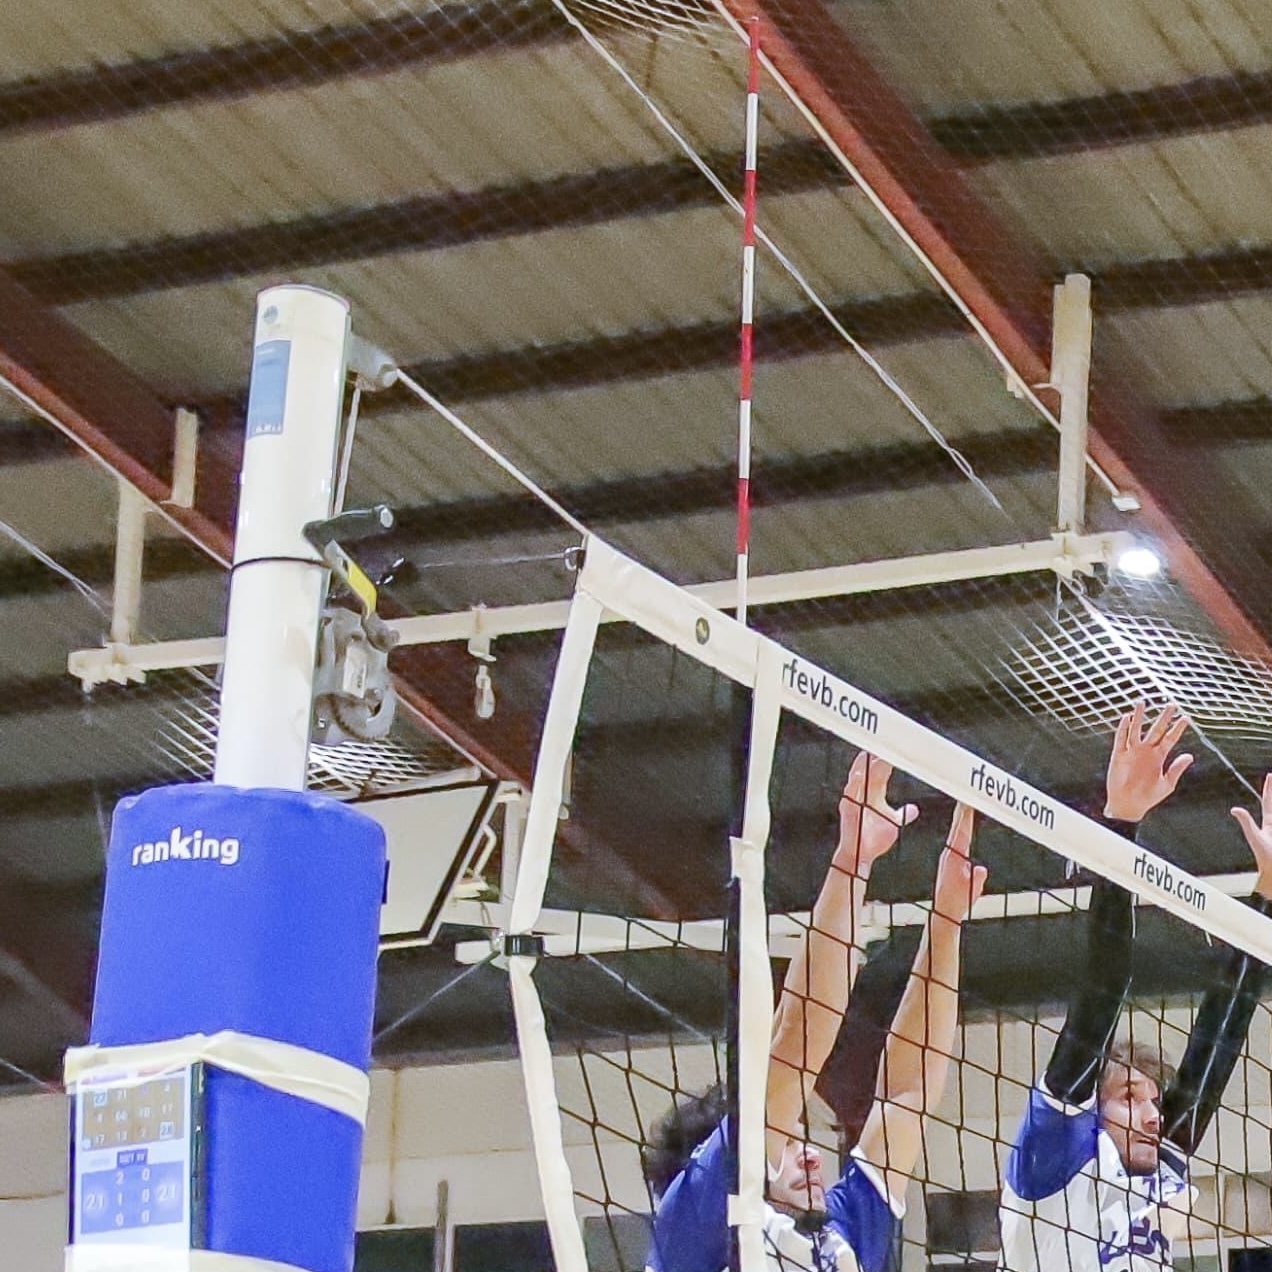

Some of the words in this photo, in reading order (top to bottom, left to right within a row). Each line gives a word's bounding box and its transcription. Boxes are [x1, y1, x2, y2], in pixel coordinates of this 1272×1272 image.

[782, 658, 879, 735] rfevb.com
[970, 764, 1055, 831] rfevb.com
[131, 826, 240, 866] ranking
[1134, 852, 1207, 912] rfevb.com
